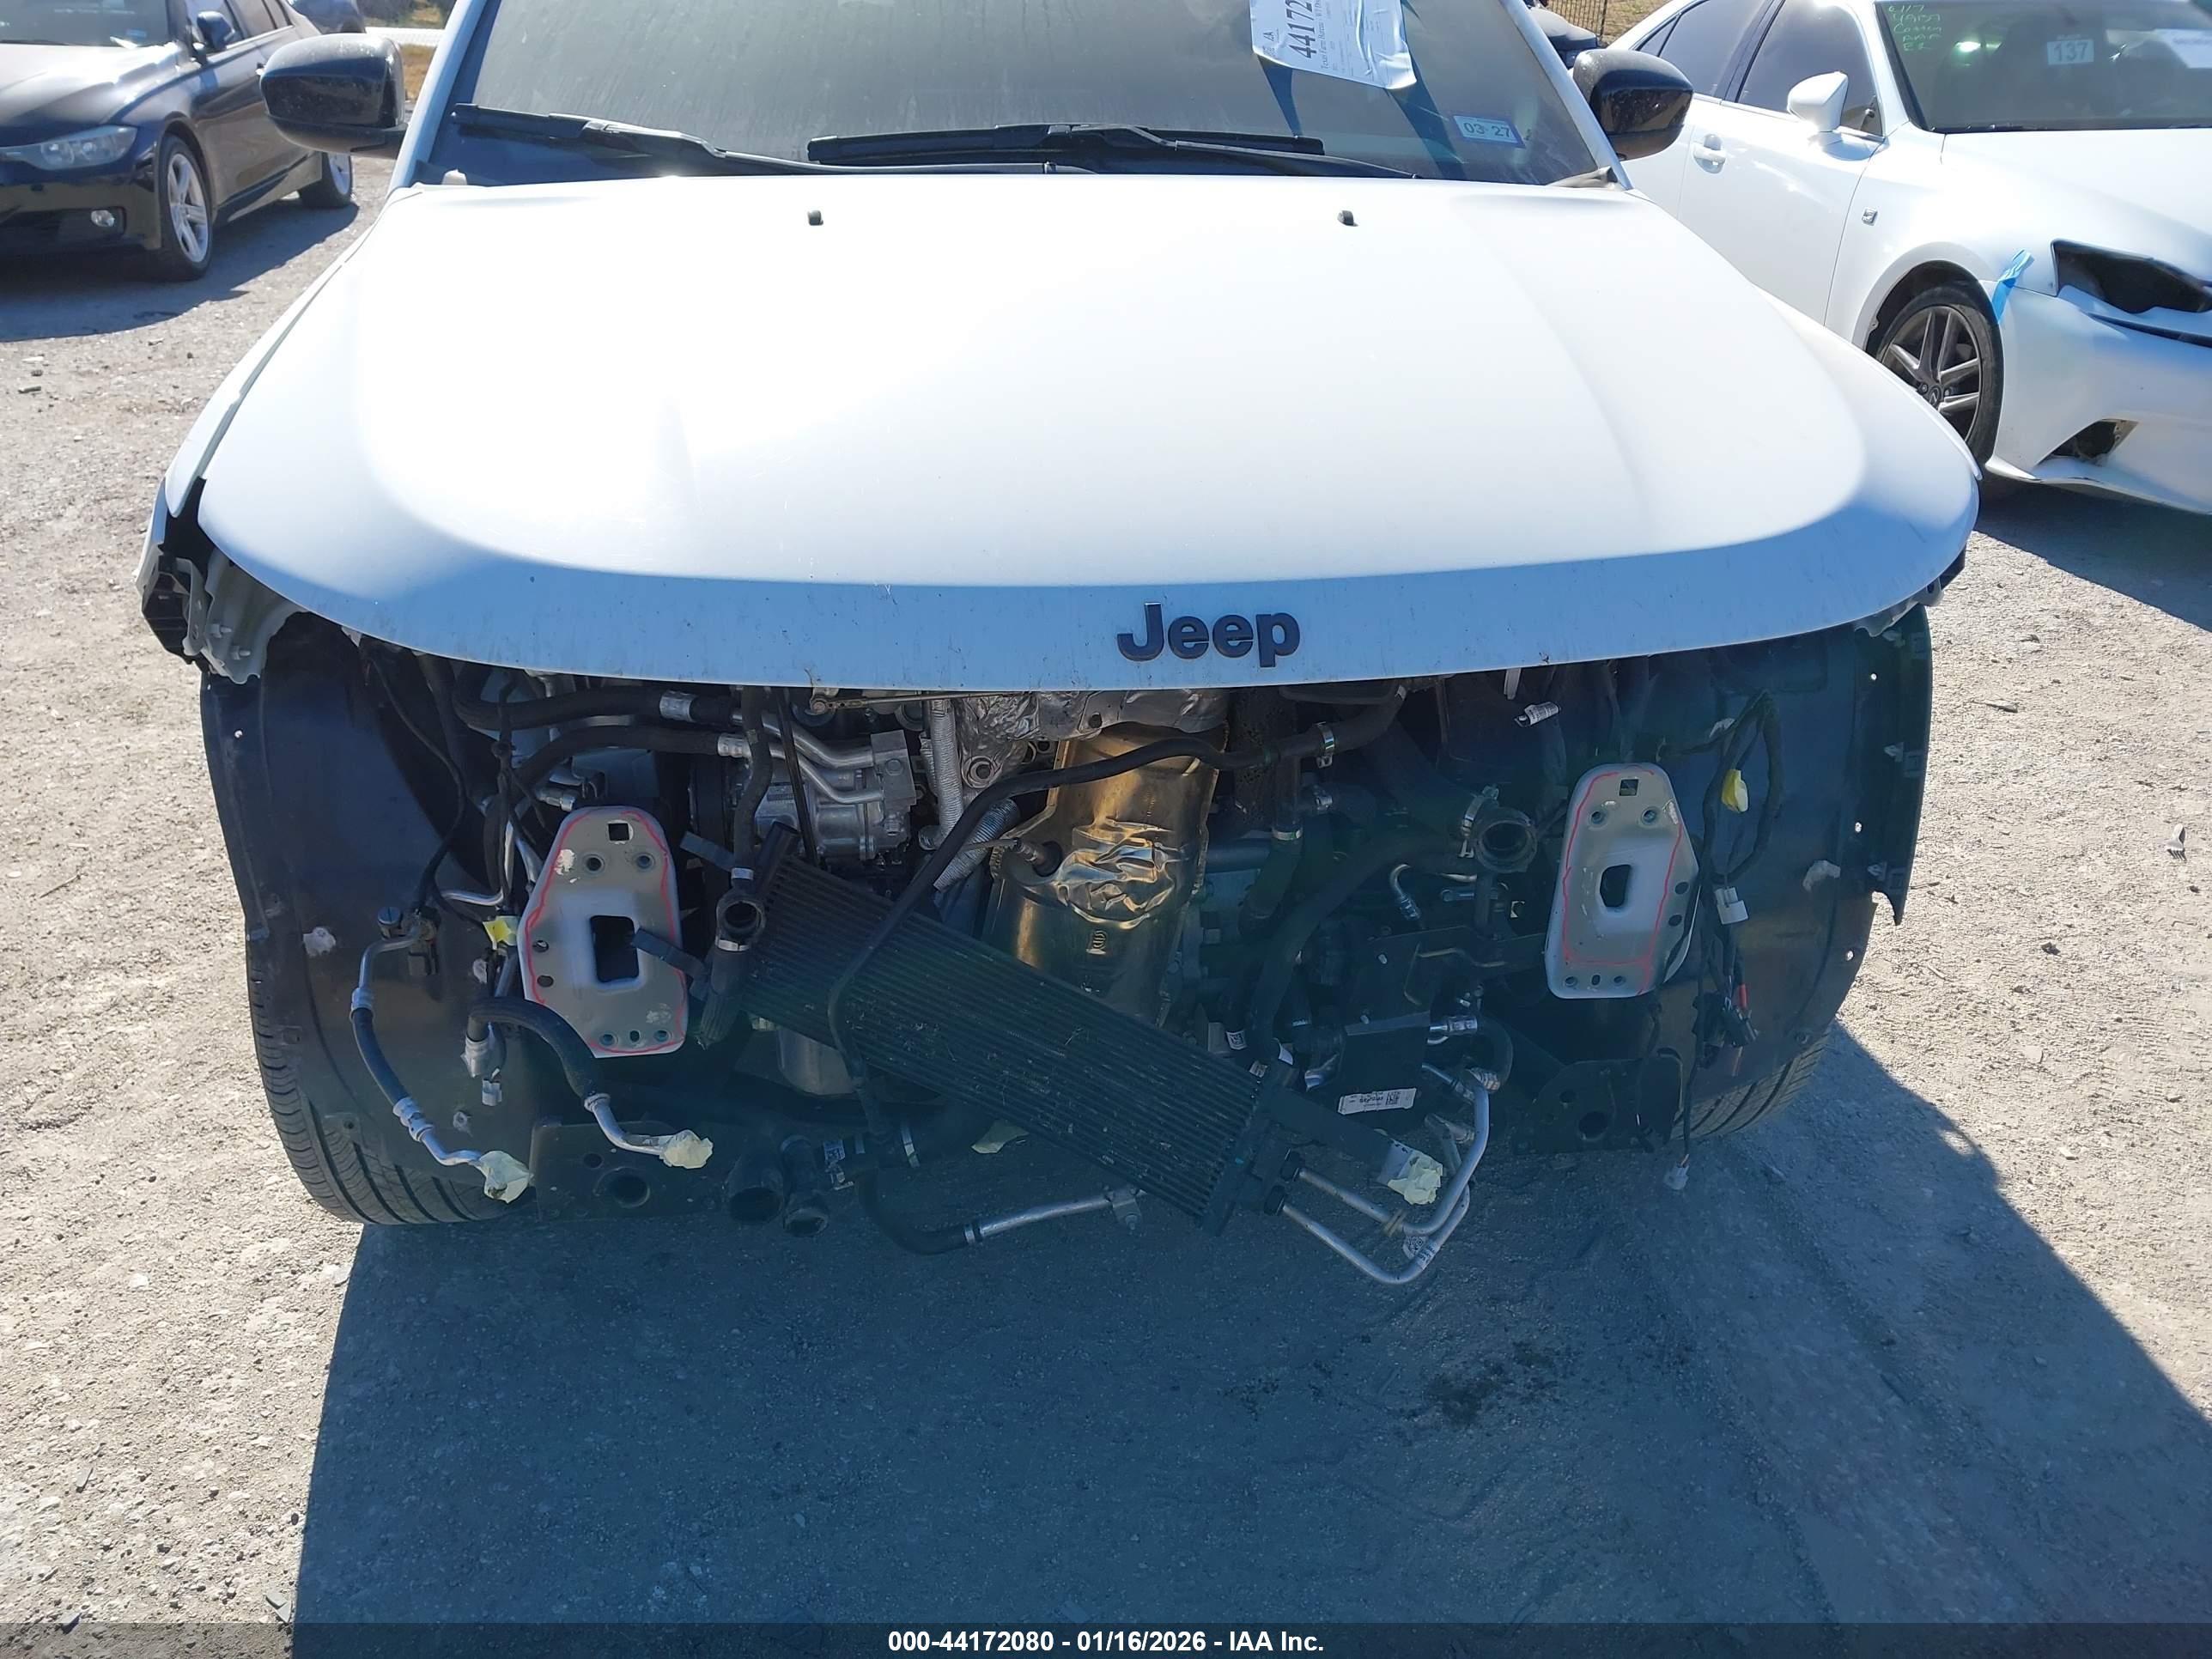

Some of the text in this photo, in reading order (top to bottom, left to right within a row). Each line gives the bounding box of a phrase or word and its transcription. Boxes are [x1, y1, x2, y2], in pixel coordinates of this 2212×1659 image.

[2053, 42, 2088, 63] 137
[1491, 125, 1510, 137] 27
[1117, 602, 1300, 667] Jeep
